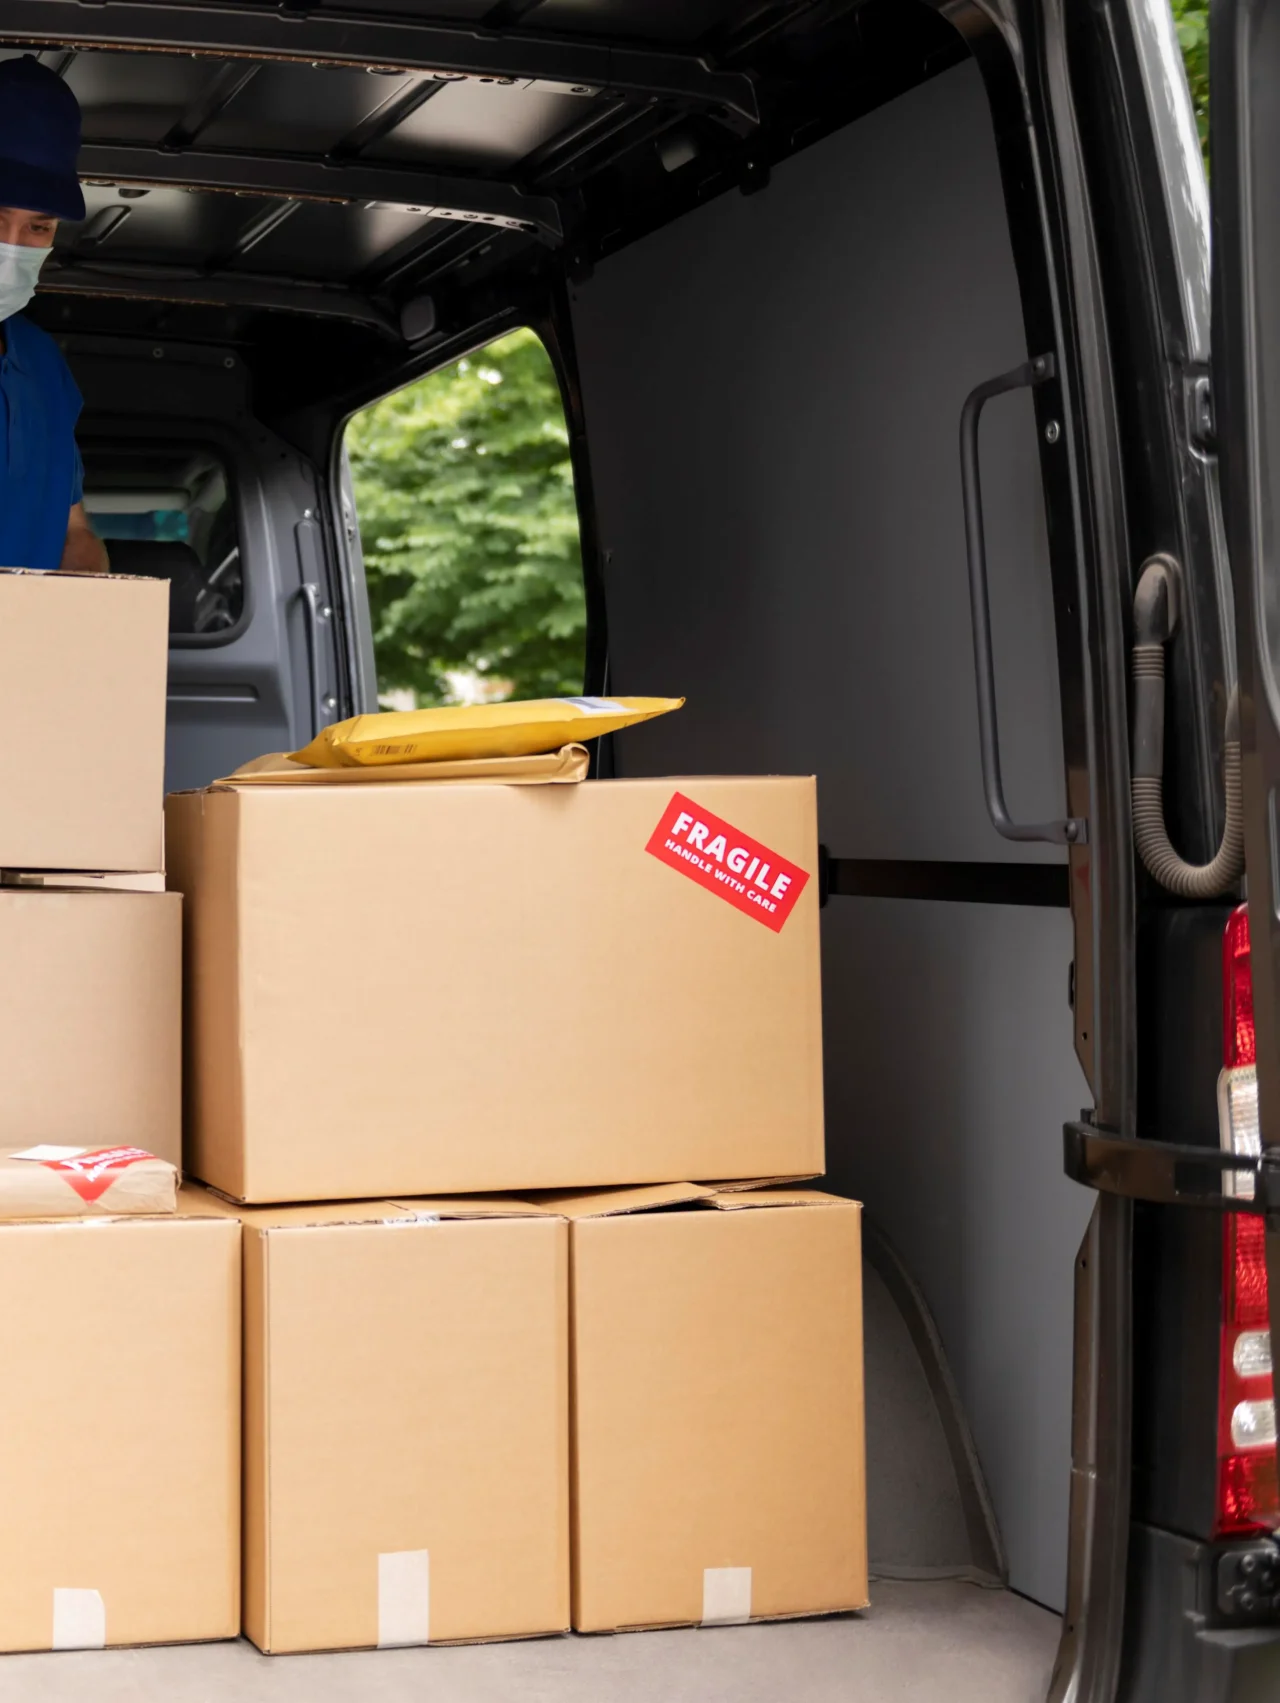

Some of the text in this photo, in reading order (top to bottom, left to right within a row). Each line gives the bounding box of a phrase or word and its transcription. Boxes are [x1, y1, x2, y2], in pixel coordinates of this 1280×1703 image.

[664, 839, 777, 913] HANDLE WITH CARE
[671, 812, 792, 900] FRAGILE
